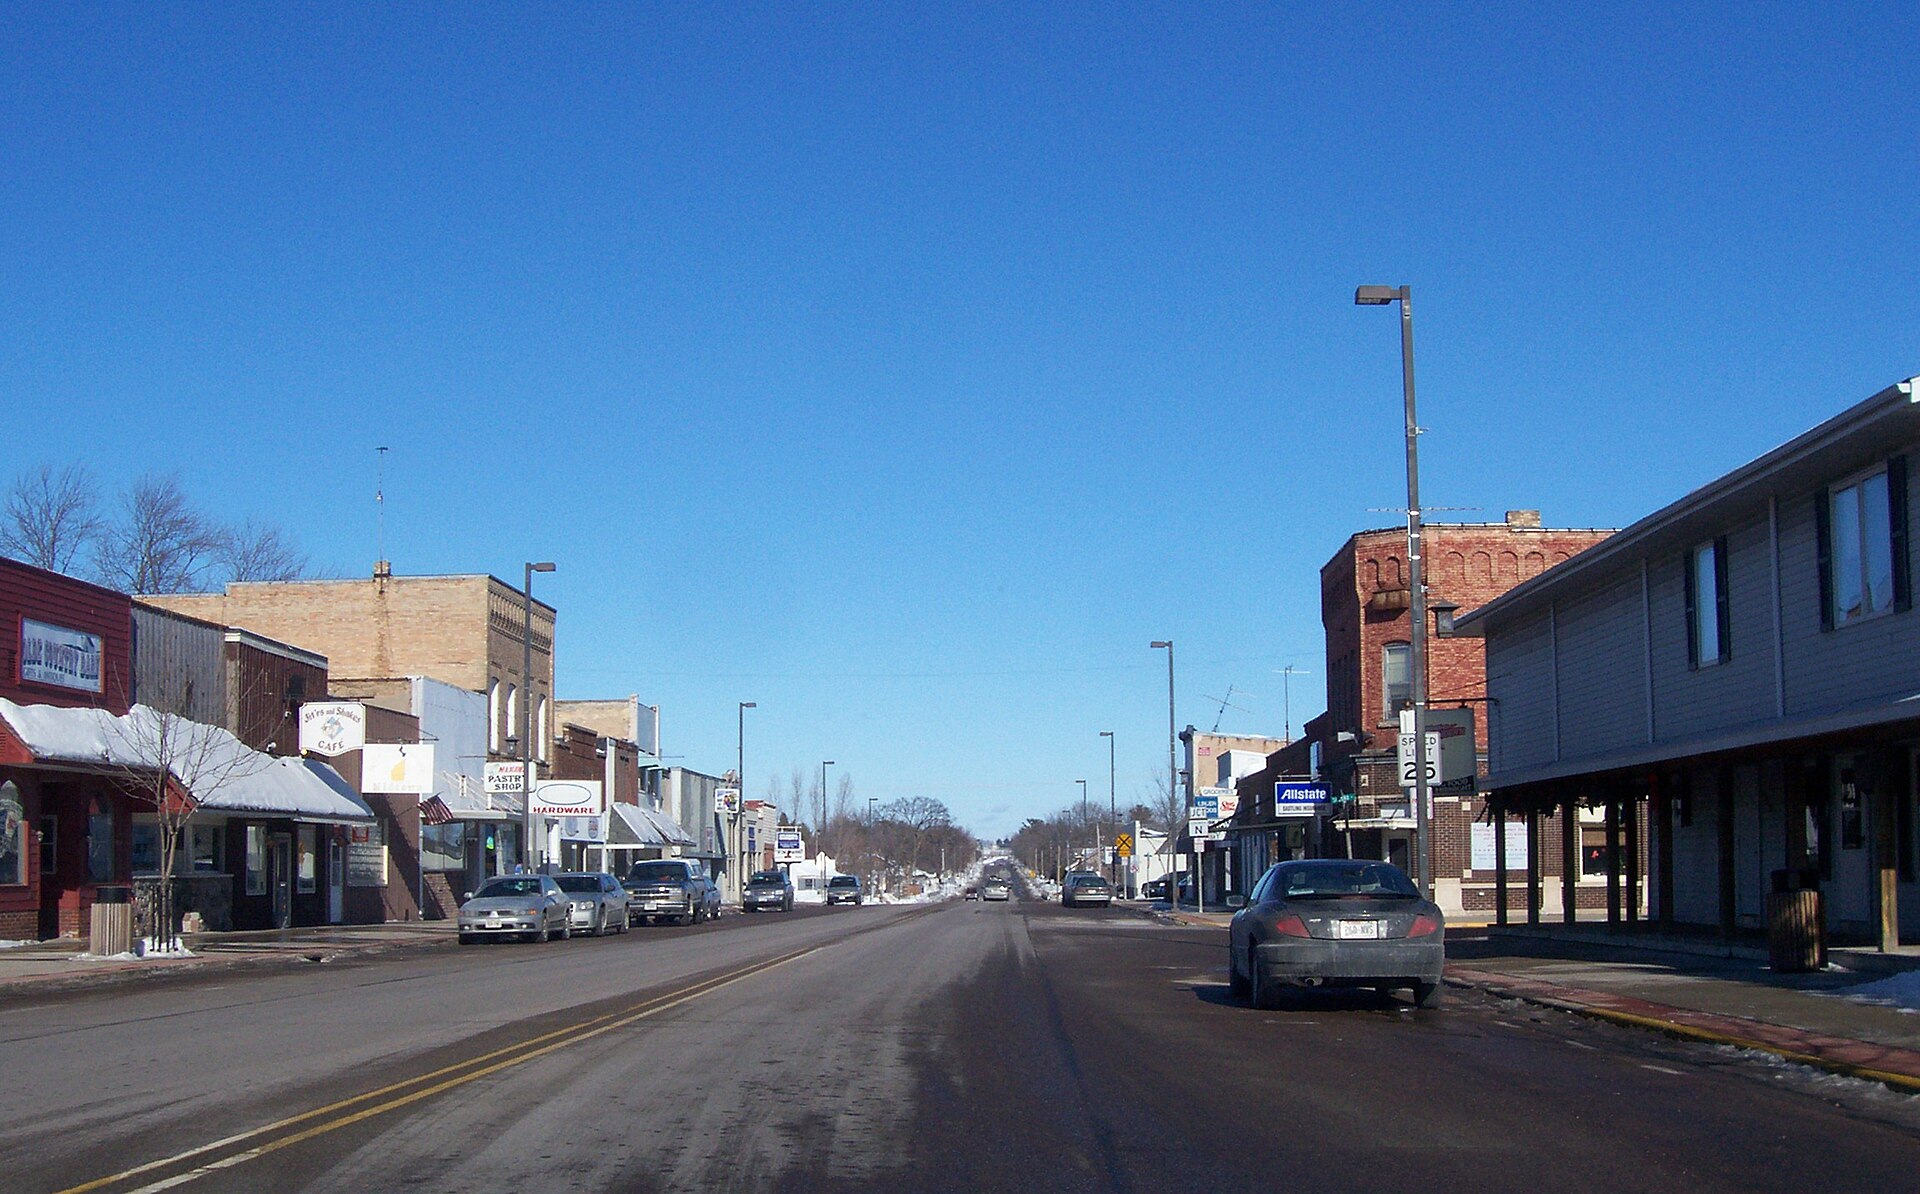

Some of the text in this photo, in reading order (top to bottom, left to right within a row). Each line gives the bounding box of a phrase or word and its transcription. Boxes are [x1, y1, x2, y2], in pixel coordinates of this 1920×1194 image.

[336, 706, 361, 723] Shakes
[318, 738, 344, 751] CAFÉ
[1402, 737, 1436, 746] SPED
[1406, 748, 1433, 757] LIT
[1404, 761, 1436, 780] 25
[488, 774, 524, 783] PASTR
[495, 783, 522, 791] SHOP
[1281, 788, 1326, 800] Allstate
[533, 806, 595, 814] HARDWARE
[1191, 808, 1205, 817] JCT
[1195, 826, 1203, 834] N
